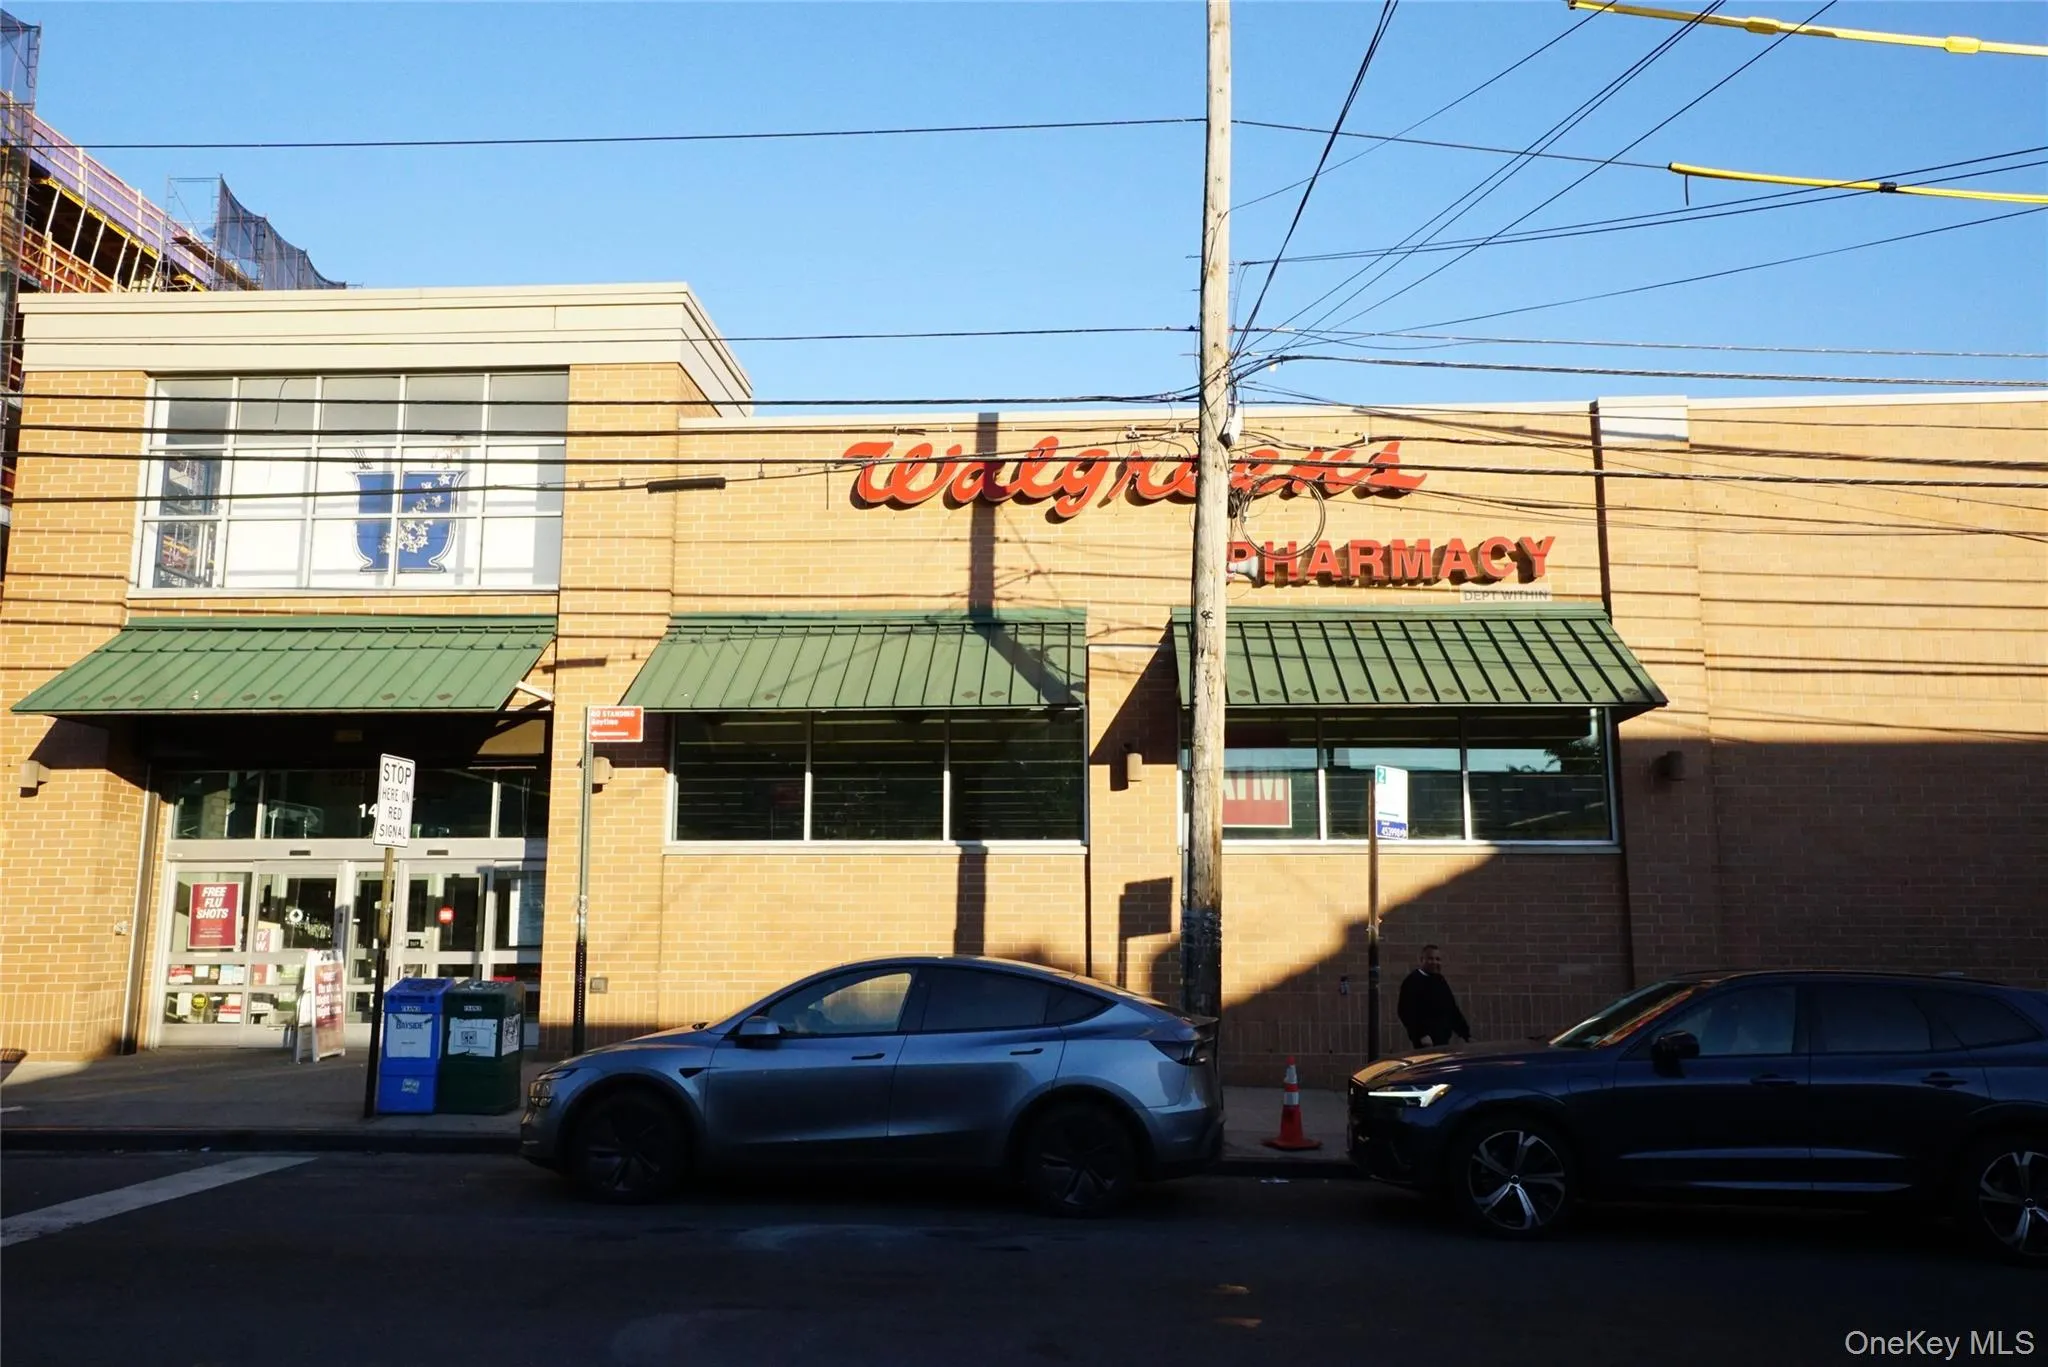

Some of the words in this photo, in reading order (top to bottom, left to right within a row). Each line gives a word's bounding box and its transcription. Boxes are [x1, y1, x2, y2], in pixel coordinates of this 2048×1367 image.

[1463, 590, 1498, 601] DEPT
[1501, 589, 1548, 600] WITHIN
[383, 763, 412, 785] STOP
[382, 787, 399, 802] HERE
[401, 790, 411, 803] ON
[388, 806, 402, 820] RED
[379, 823, 406, 839] SIGNAL
[201, 886, 227, 897] FREE
[204, 897, 223, 908] FLU
[195, 907, 229, 919] SHOTS
